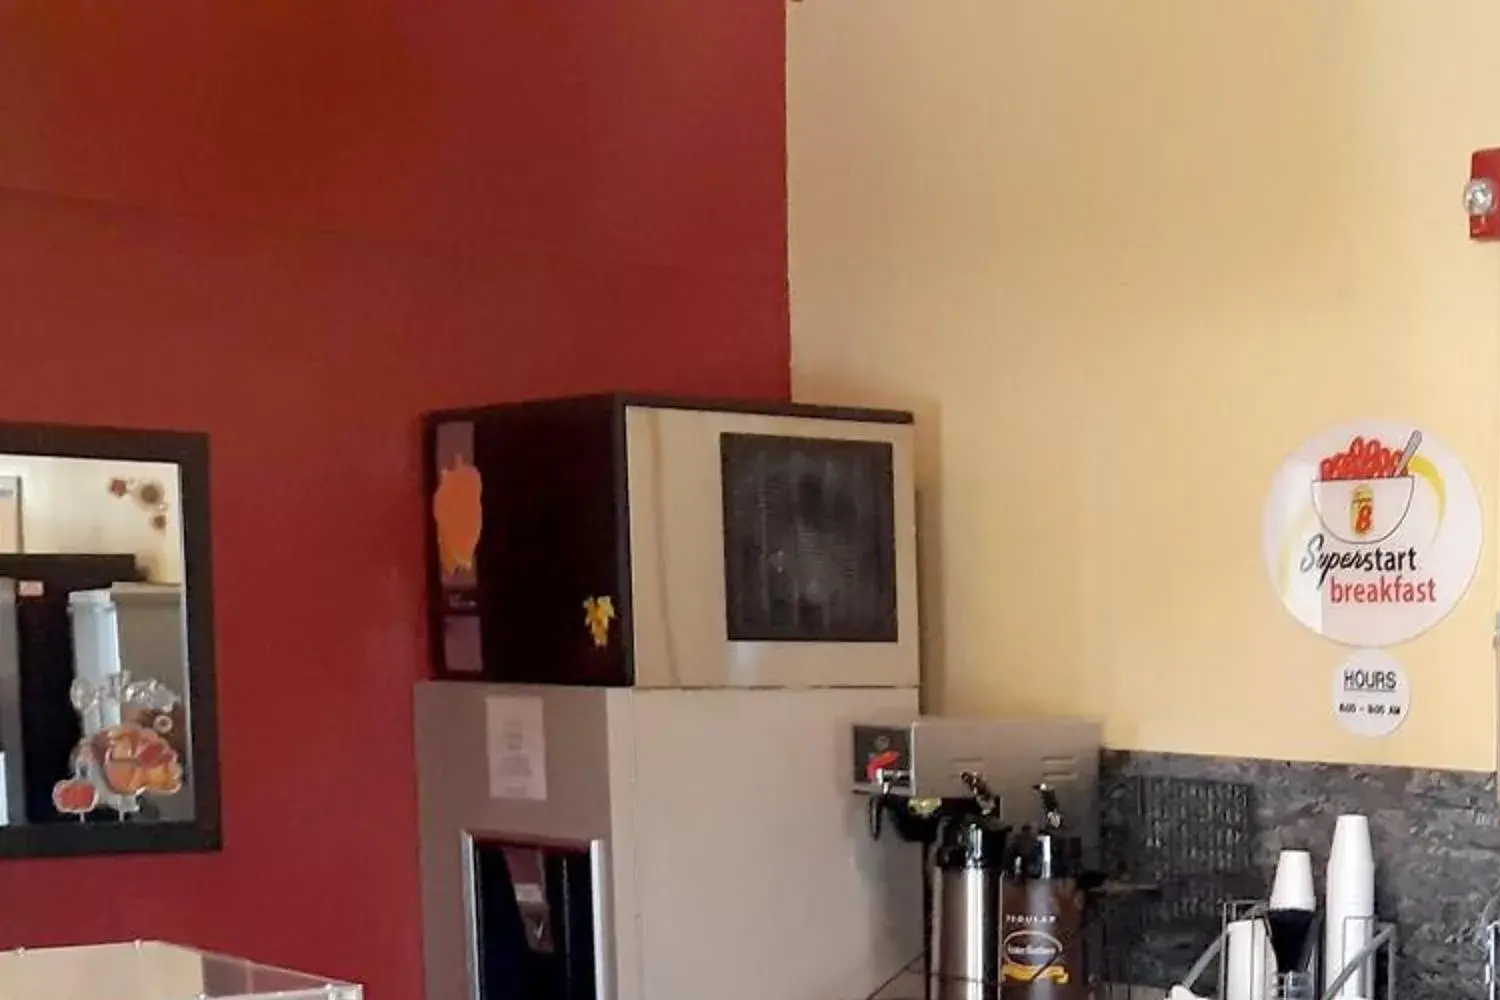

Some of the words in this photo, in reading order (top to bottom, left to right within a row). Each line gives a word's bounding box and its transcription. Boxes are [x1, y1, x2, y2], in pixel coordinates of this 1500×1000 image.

[1300, 533, 1417, 590] Superstart
[1330, 575, 1437, 604] breakfast
[1343, 669, 1397, 689] HOURS
